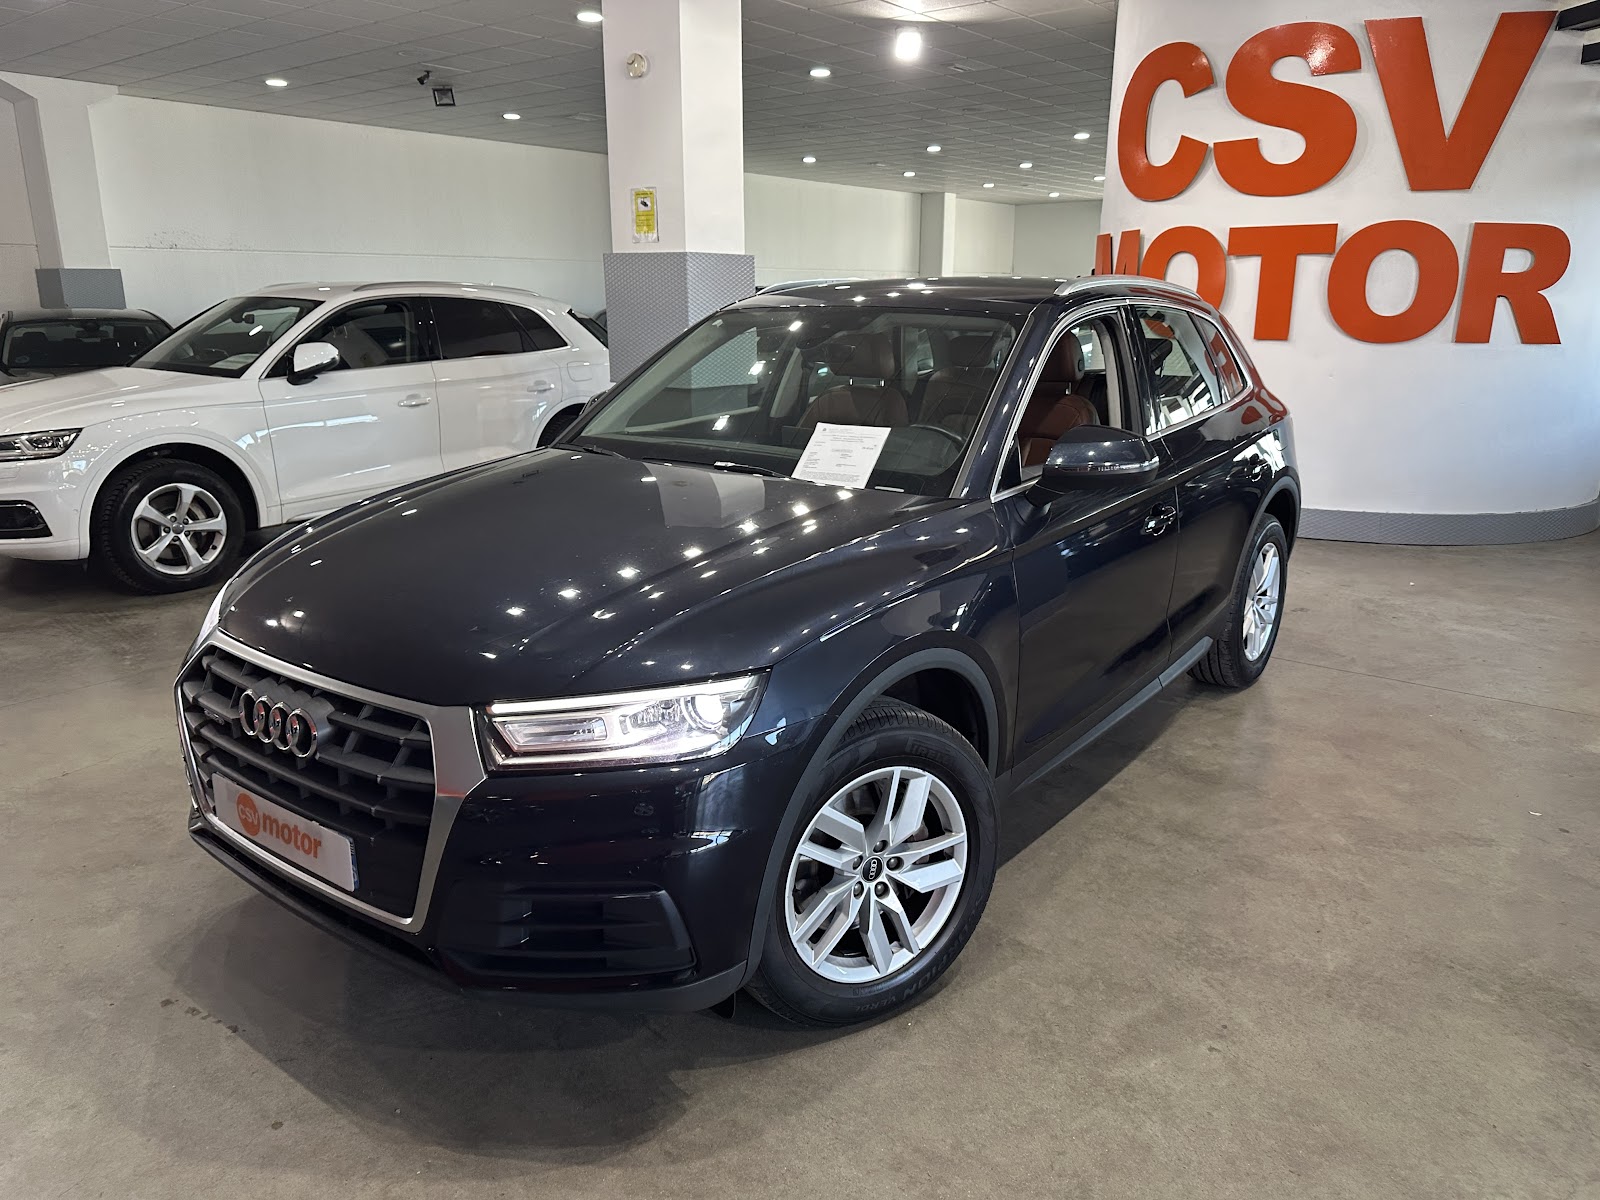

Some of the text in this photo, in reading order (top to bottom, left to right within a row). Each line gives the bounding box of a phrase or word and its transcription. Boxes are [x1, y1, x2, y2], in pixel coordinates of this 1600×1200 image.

[1117, 10, 1559, 202] CSV
[238, 804, 259, 825] CSV
[262, 811, 322, 859] motor
